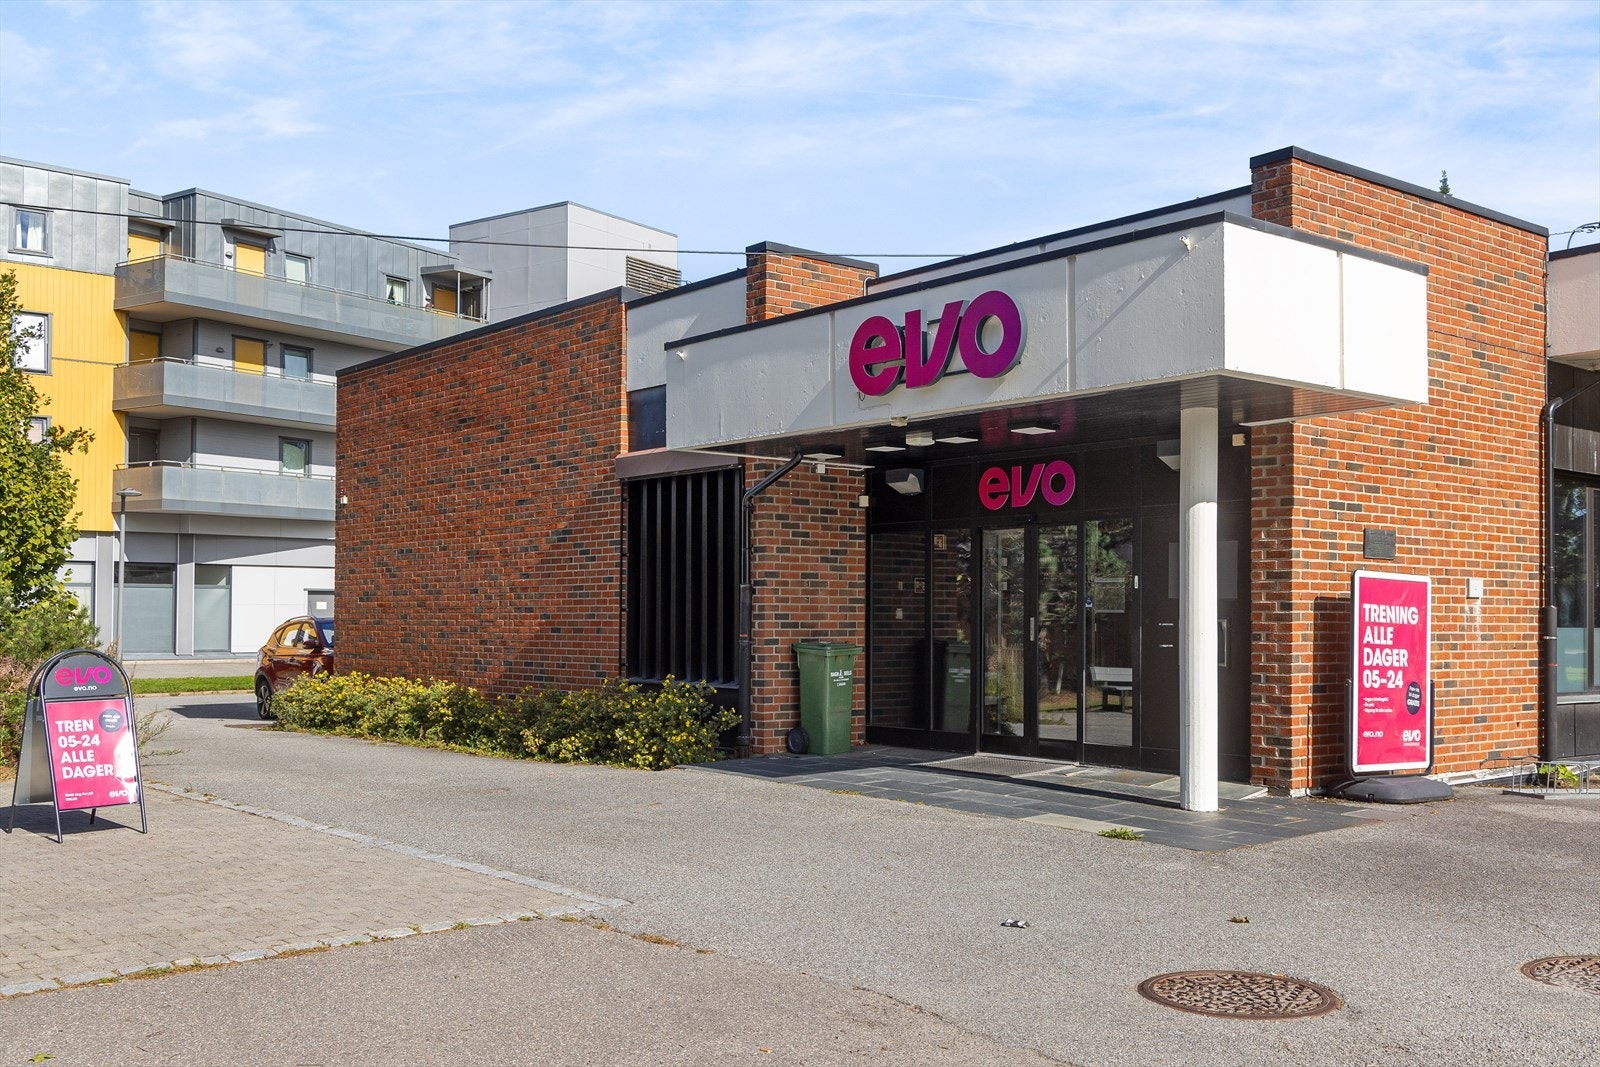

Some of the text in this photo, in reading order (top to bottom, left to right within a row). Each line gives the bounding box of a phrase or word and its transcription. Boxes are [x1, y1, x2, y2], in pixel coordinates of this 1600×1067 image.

[848, 290, 1024, 396] evo
[979, 460, 1076, 510] evo
[1362, 603, 1419, 625] TRENING
[1362, 625, 1394, 645] ALLE
[1363, 647, 1409, 667] DAGER
[55, 666, 112, 686] evo
[1362, 669, 1404, 689] 05-24
[55, 719, 94, 733] TREN
[1363, 730, 1384, 738] evo.no
[58, 734, 101, 748] 05-24
[1402, 729, 1421, 742] evo
[61, 750, 95, 763] ALLE
[62, 764, 114, 779] DAGER
[108, 789, 129, 798] evo
